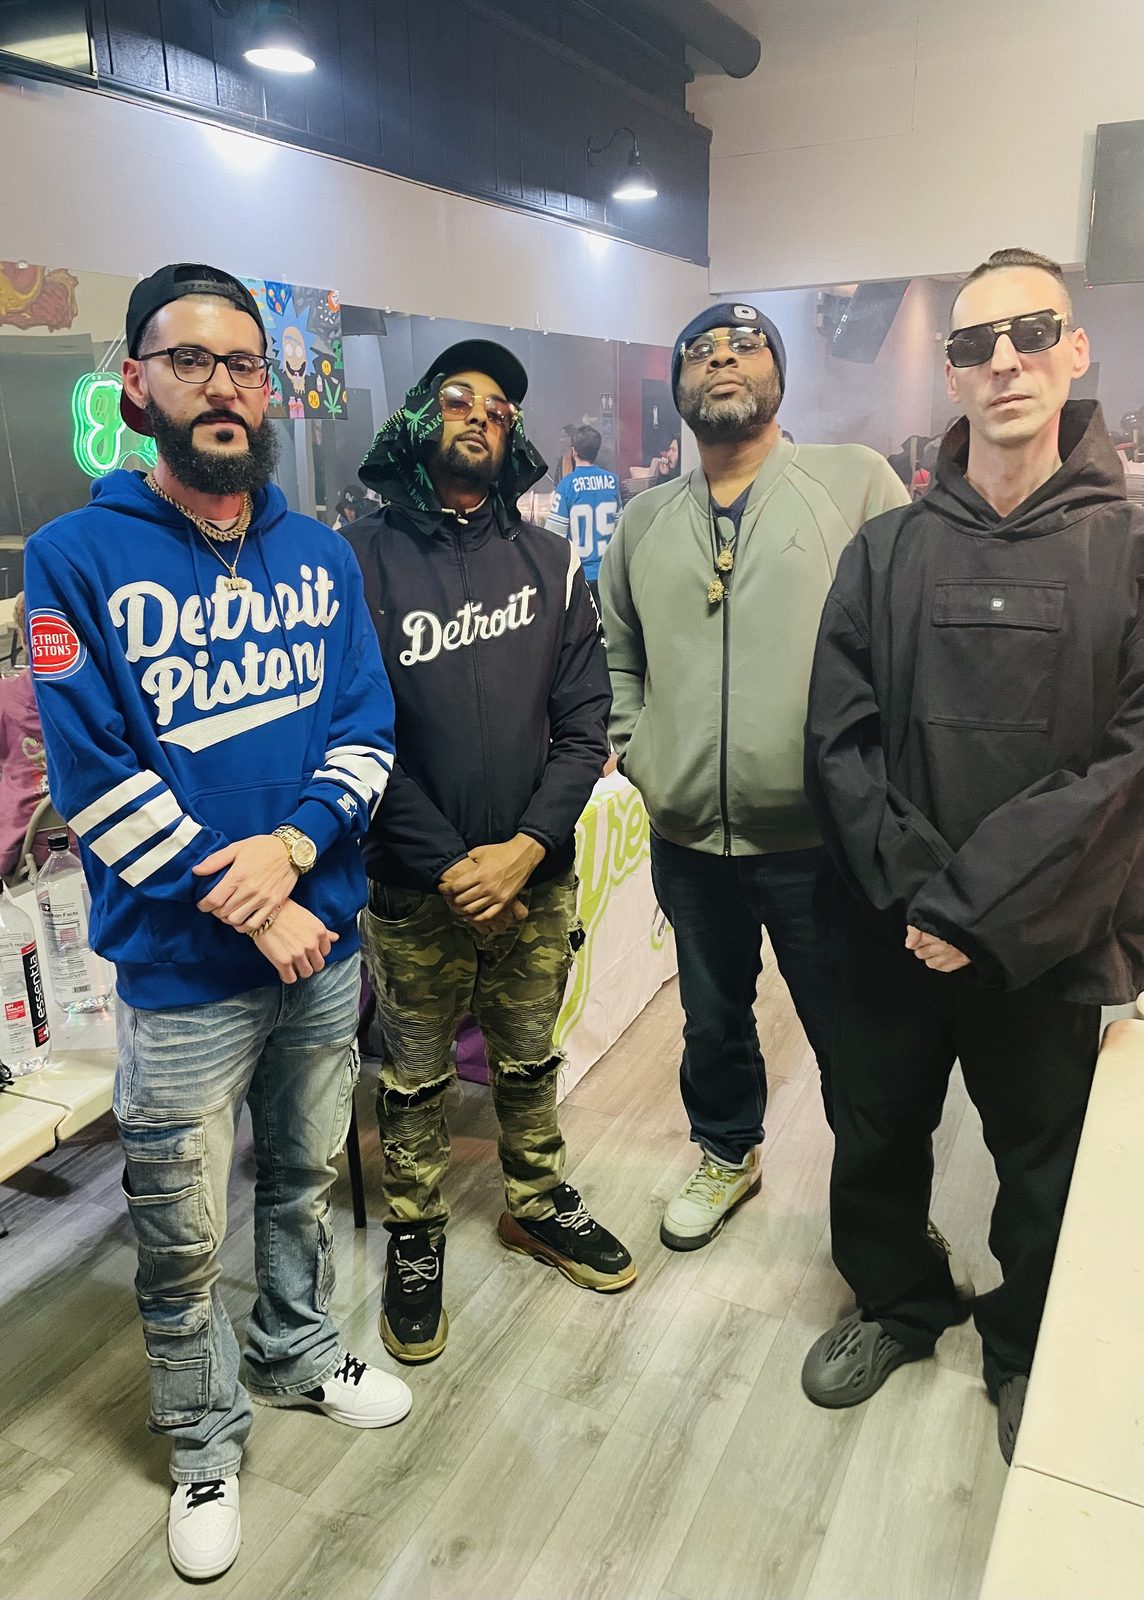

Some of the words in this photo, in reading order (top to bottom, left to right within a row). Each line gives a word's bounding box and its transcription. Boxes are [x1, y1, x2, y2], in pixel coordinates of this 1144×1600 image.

[33, 633, 69, 645] ETROIT
[107, 564, 340, 662] Detroit
[399, 585, 538, 666] Detroit
[33, 645, 71, 658] ISTONS
[30, 954, 45, 1019] essentia
